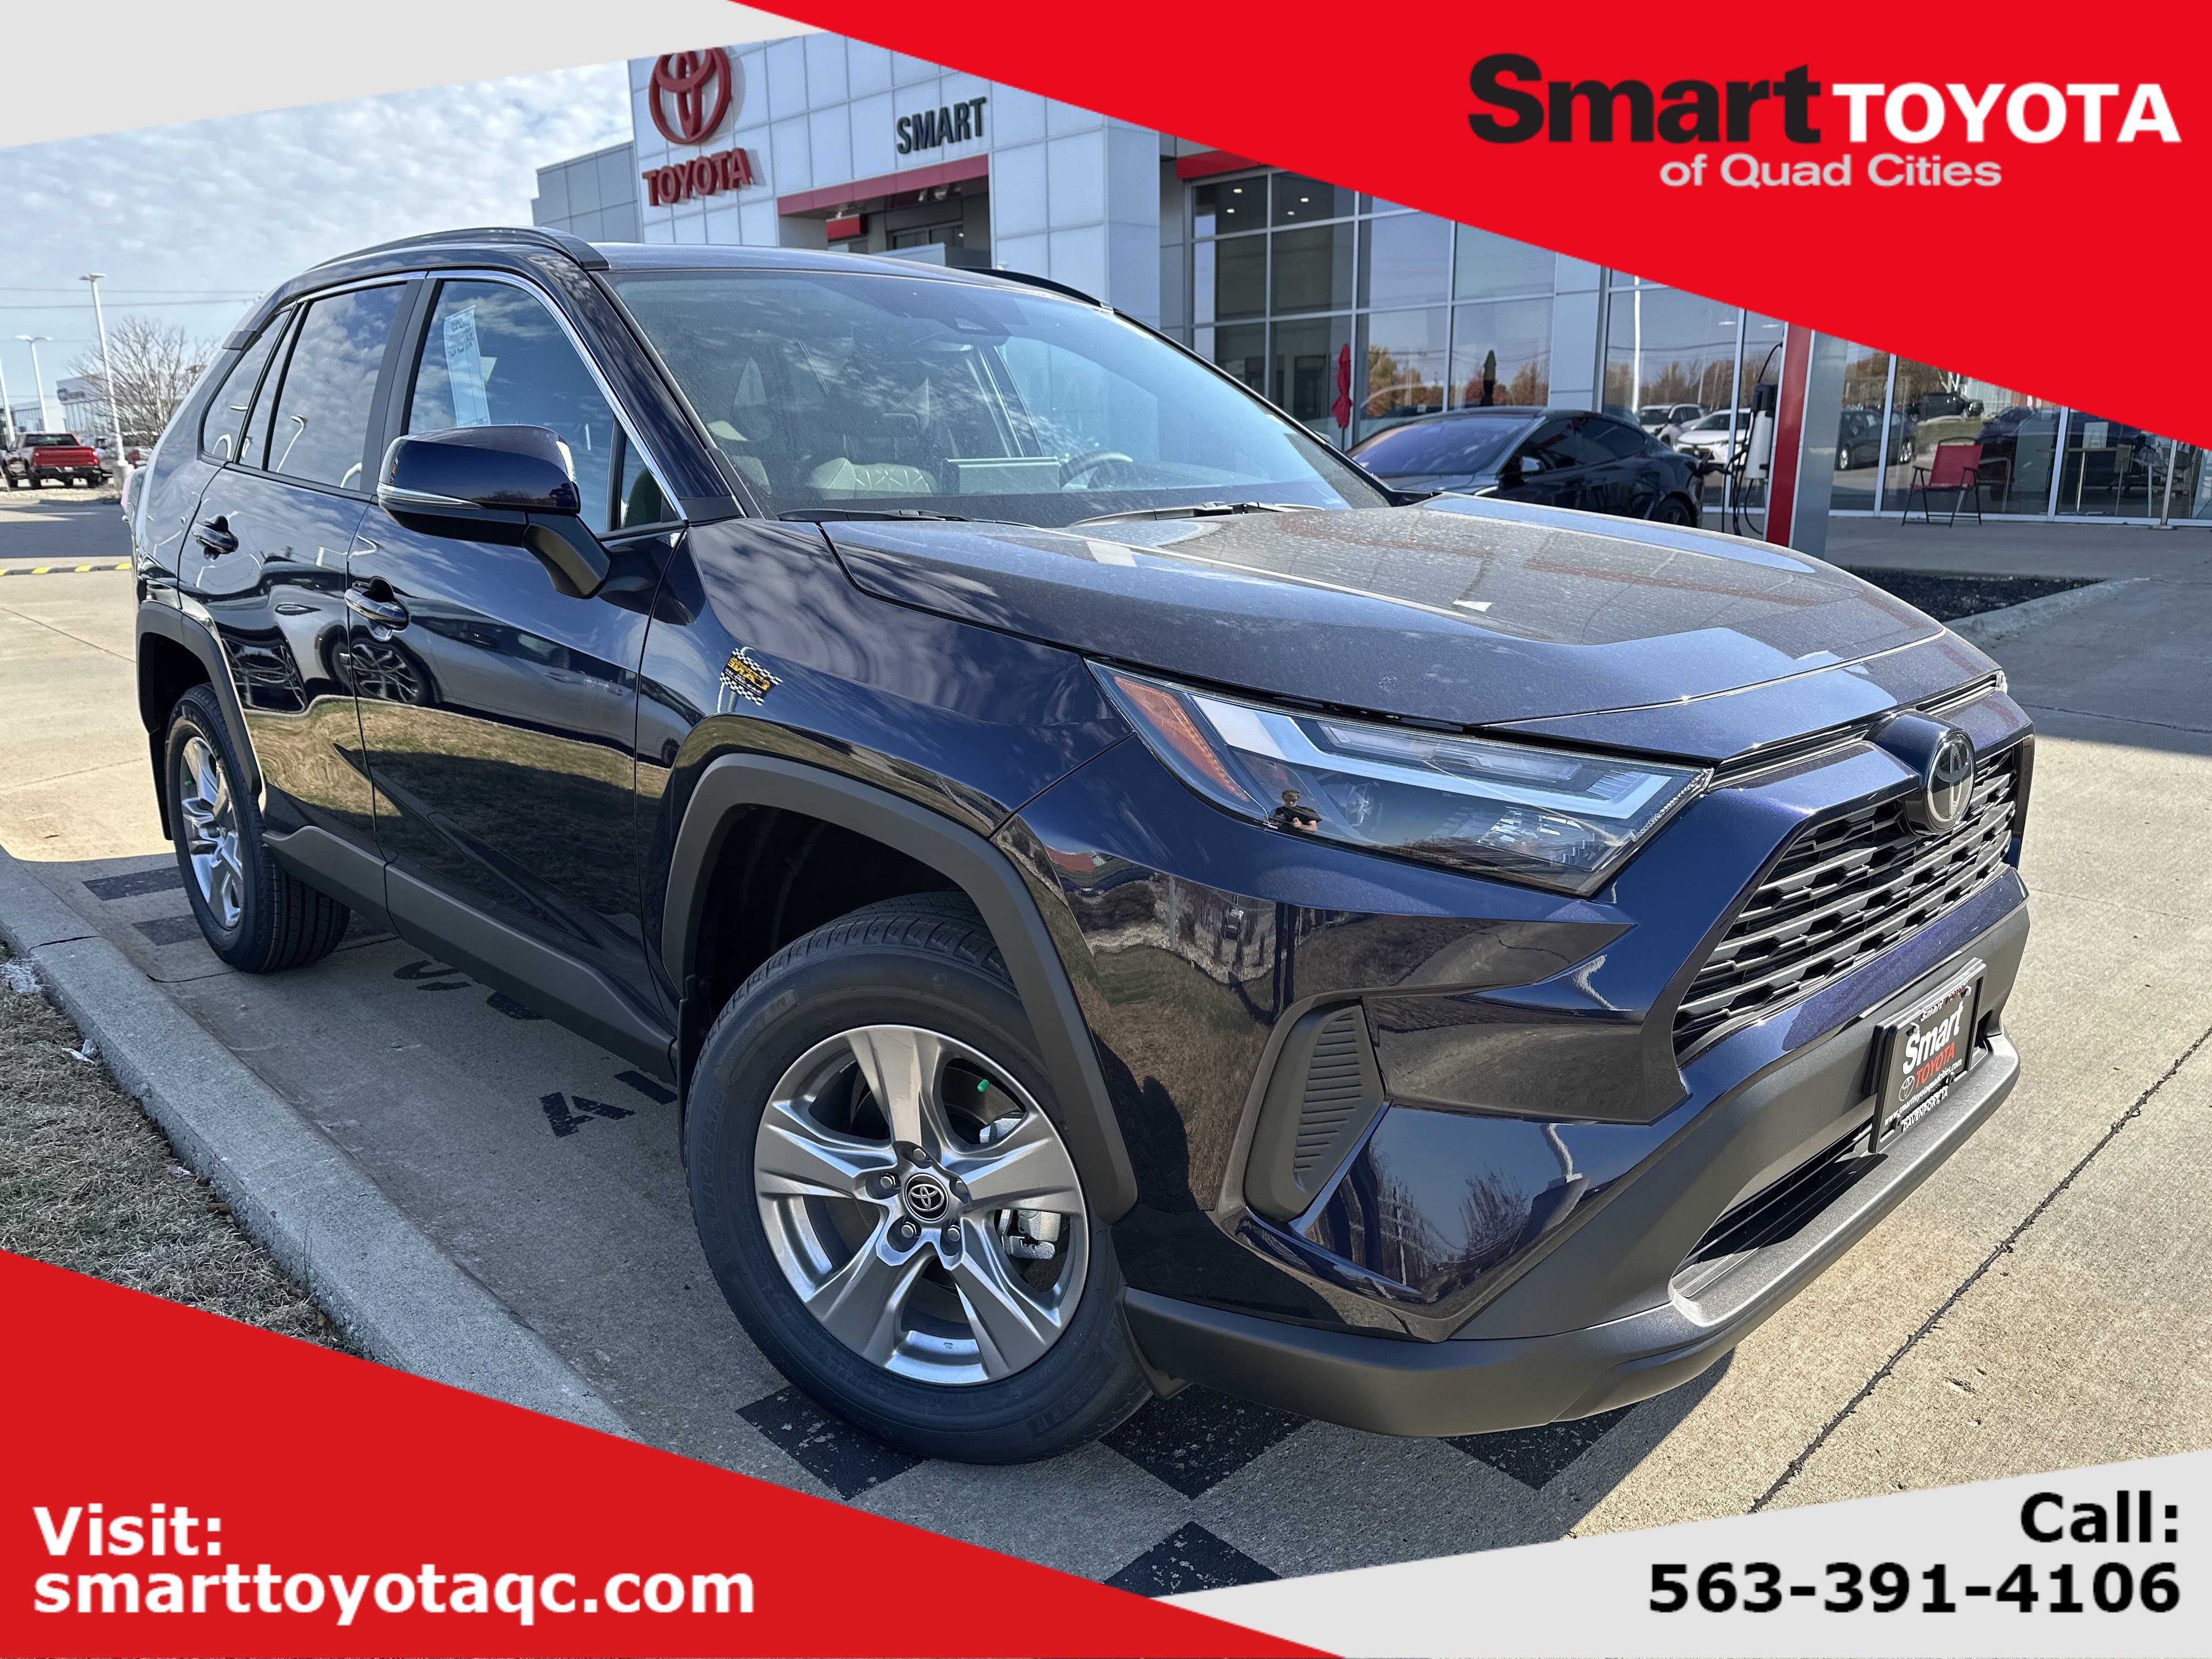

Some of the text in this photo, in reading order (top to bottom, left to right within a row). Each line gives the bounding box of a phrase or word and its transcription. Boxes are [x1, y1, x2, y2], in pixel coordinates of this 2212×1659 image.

[897, 97, 986, 154] SMART
[642, 148, 756, 206] TOYOTA
[1903, 1000, 1963, 1075] Smart
[1915, 1042, 1955, 1088] TOYOTA
[697, 1085, 725, 1221] MICHELIN
